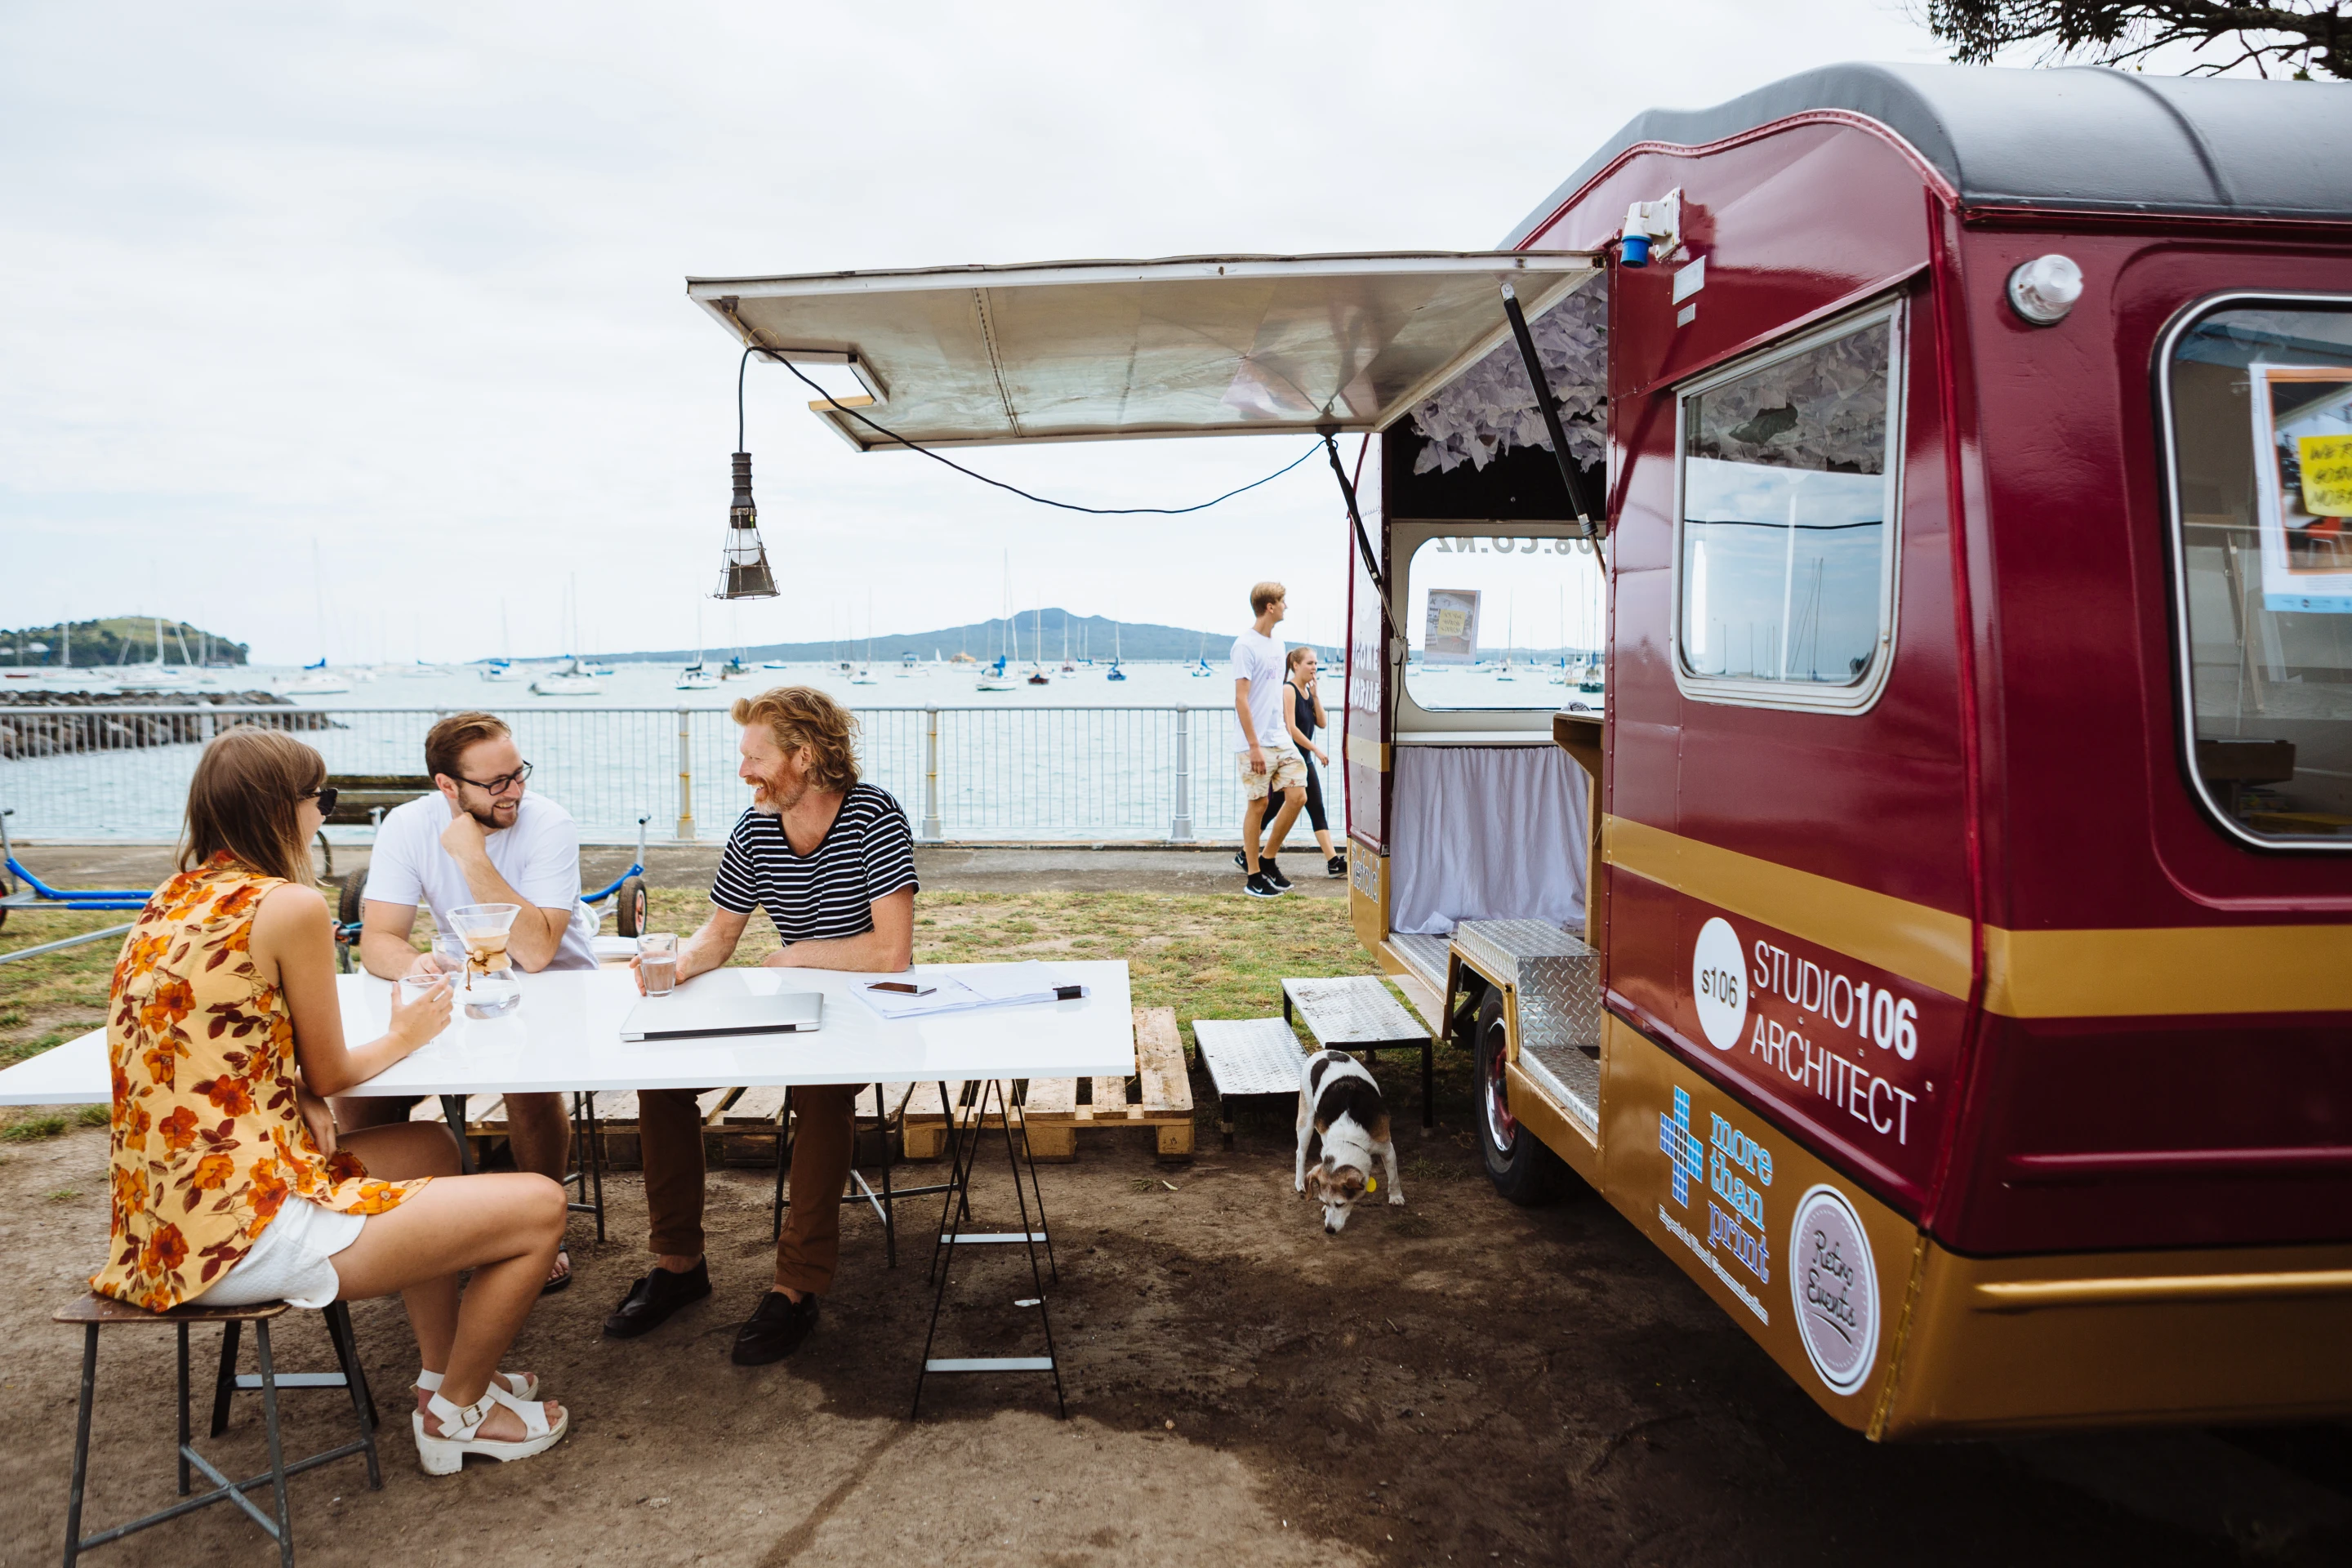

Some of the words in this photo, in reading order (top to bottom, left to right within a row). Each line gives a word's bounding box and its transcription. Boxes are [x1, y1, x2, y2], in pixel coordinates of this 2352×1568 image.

[1699, 966, 1738, 1009] s106
[1753, 939, 1918, 1061] STUDIO106
[1749, 1013, 1918, 1145] ARCHITECT
[1709, 1111, 1773, 1187] more
[1709, 1147, 1766, 1232] than
[1707, 1199, 1771, 1285] print
[1812, 1229, 1855, 1287] Retro
[1806, 1268, 1858, 1329] Events
